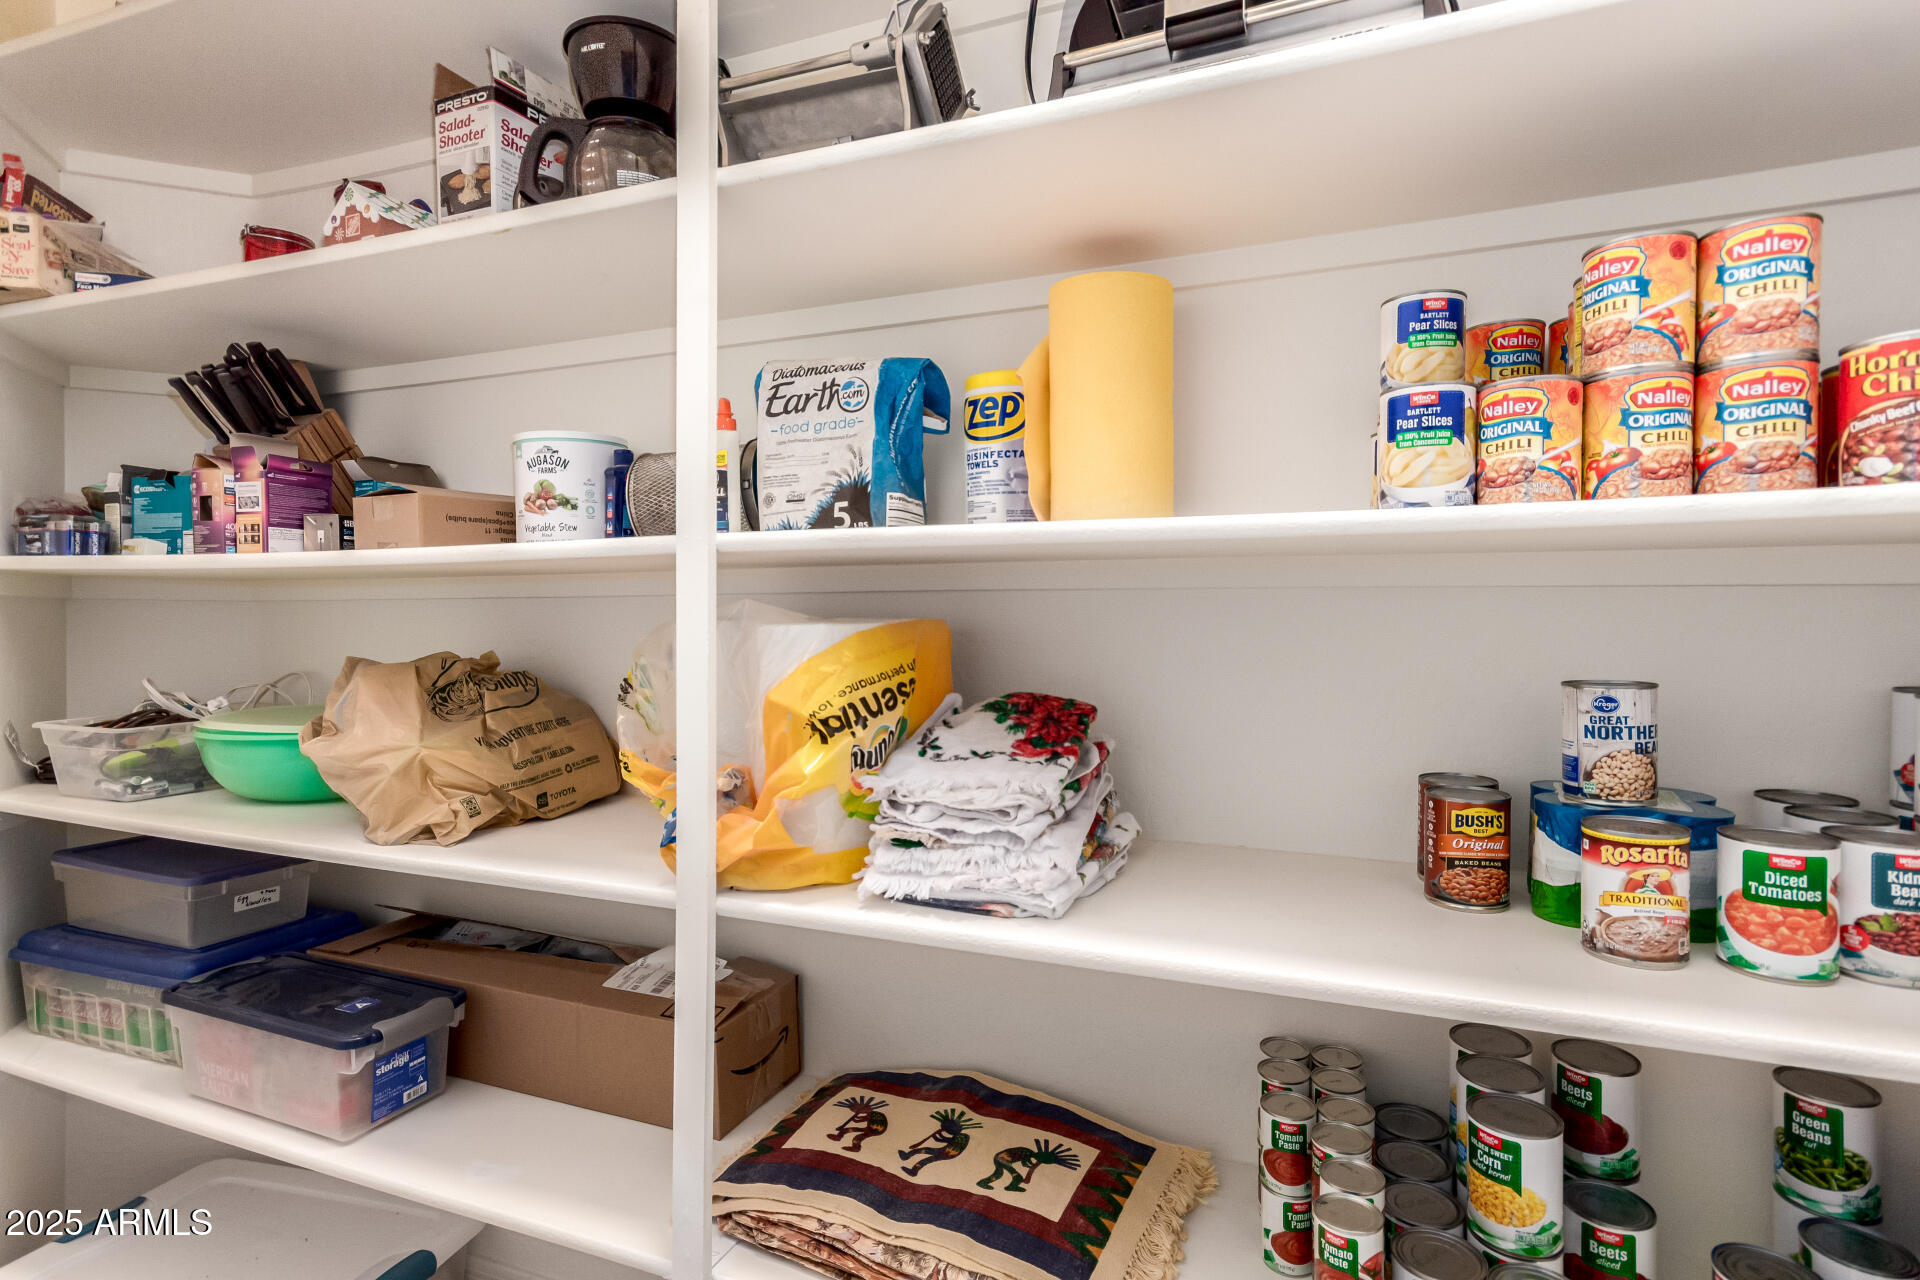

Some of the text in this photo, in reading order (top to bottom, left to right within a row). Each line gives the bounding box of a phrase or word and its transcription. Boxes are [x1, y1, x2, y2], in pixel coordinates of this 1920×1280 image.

[436, 91, 488, 114] PRESTO
[438, 114, 475, 135] Salad-
[438, 128, 486, 149] Shooter
[1733, 236, 1805, 259] Nalley
[1584, 259, 1635, 285] Nalley
[1723, 258, 1808, 283] ORIGINAL
[1736, 279, 1799, 298] CHILI
[1585, 298, 1628, 322] CHILI
[1409, 320, 1457, 332] Pear Slices
[1497, 335, 1540, 348] Nalley
[1490, 352, 1541, 364] ORIGINAL
[772, 362, 866, 382] Diatomaceous
[1499, 366, 1537, 377] CHILI
[1732, 379, 1803, 398] Nalley
[1862, 368, 1920, 398] Chi
[765, 376, 842, 418] Earth
[1637, 389, 1692, 407] Nalley
[967, 393, 1021, 431] Zep
[1484, 400, 1538, 419] Nalley
[1723, 402, 1807, 421] ORIGINAL
[1396, 416, 1453, 430] Pear Slices
[1480, 420, 1544, 440] ORIGINAL
[1736, 421, 1797, 437] CHILI
[1641, 430, 1688, 444] CHILI
[967, 449, 1025, 462] DISINFECTA
[1485, 438, 1532, 455] CHILI
[526, 454, 570, 471] AUGASON
[967, 459, 999, 470] TOWELS
[833, 500, 851, 529] 5
[524, 521, 578, 534] Vegetable Stew
[1592, 698, 1619, 711] Kroger
[1589, 715, 1630, 725] GREAT
[1584, 724, 1657, 741] NORTHE
[1635, 741, 1658, 755] BEA
[551, 786, 577, 800] TOYOTA
[1455, 813, 1503, 829] BUSH'S
[1452, 838, 1505, 852] Original
[1600, 844, 1689, 870] Rosarita
[1764, 870, 1808, 888] Diced
[1887, 870, 1920, 885] Kidn
[1748, 881, 1822, 902] Tomatoes
[1891, 884, 1920, 897] Bea
[1609, 894, 1683, 908] TRADITIONAL
[375, 1054, 410, 1077] storage
[1561, 1078, 1593, 1101] Beets
[1792, 1110, 1830, 1133] Green
[1274, 1130, 1304, 1143] Tomato
[1791, 1122, 1832, 1146] Beans
[1278, 1139, 1301, 1151] Paste
[1477, 1149, 1502, 1171] Corn
[1490, 1148, 1513, 1162] SWEET
[1320, 1238, 1353, 1260] Tomato
[1590, 1239, 1628, 1262] Beets
[1324, 1250, 1349, 1270] Paste
